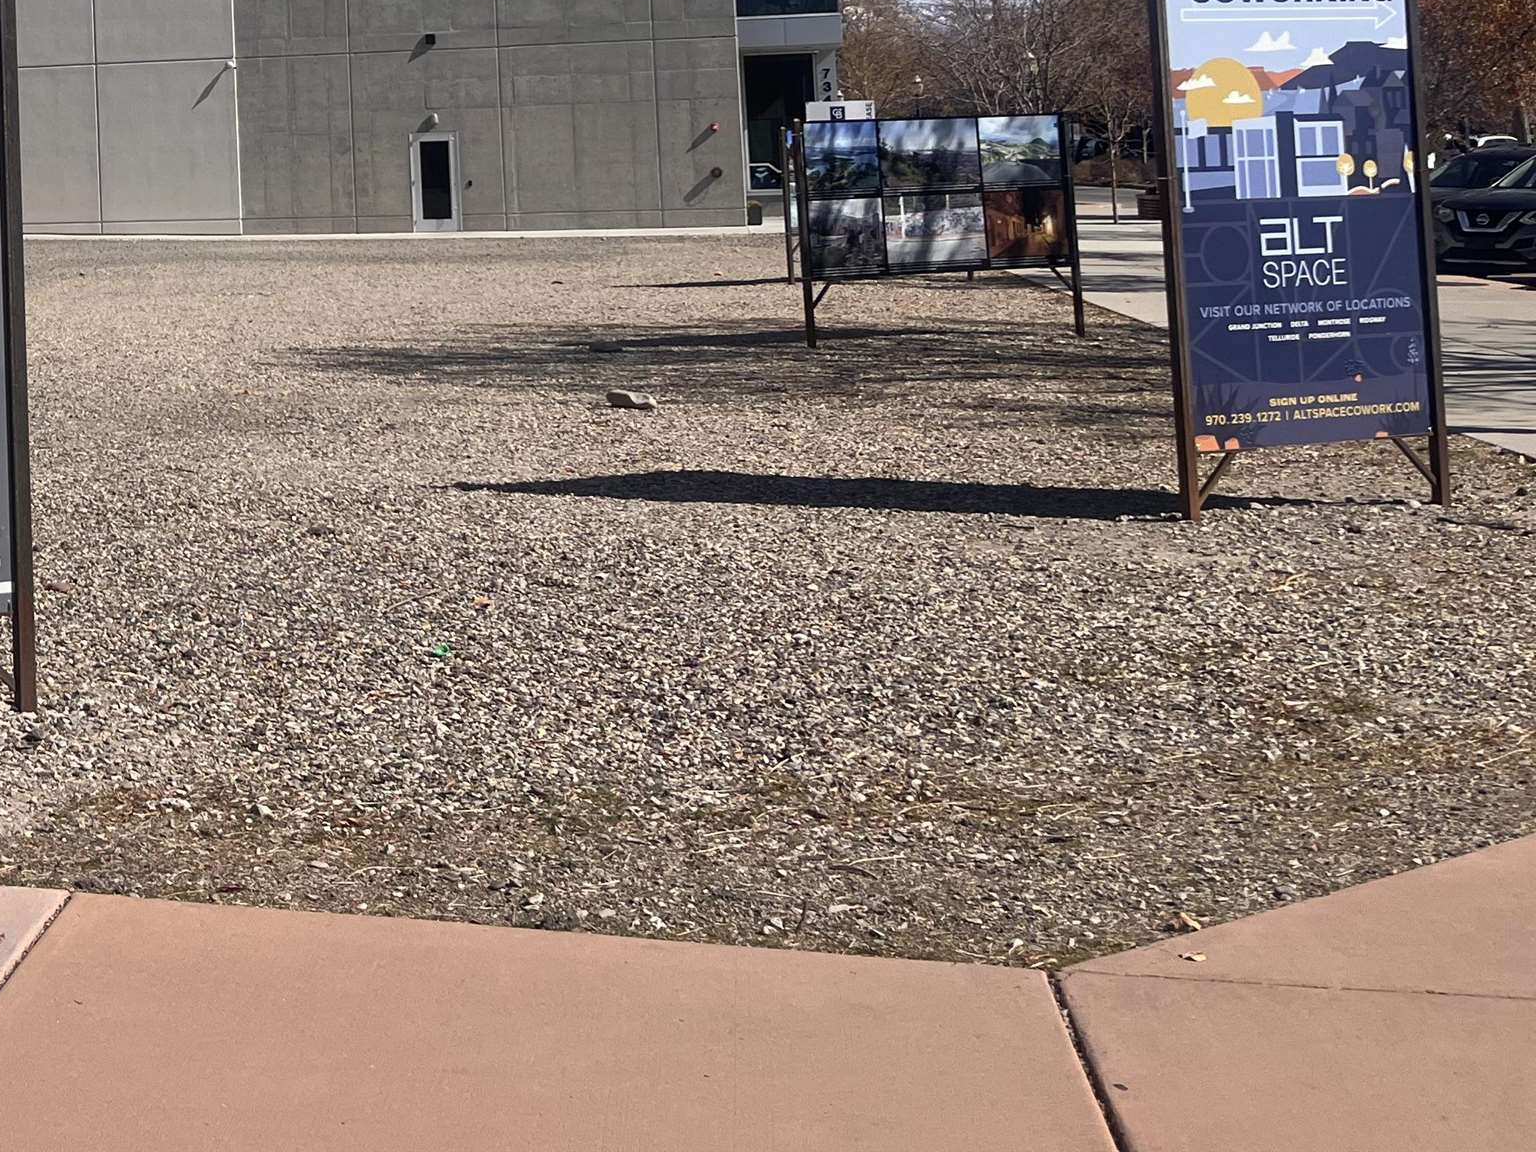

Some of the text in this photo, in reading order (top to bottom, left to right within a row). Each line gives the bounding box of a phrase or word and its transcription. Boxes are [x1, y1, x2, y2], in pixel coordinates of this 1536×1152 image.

[1262, 258, 1348, 289] SPACE
[1200, 296, 1411, 318] VISIT OUR NETWORK OF LOCATIONS
[1269, 393, 1359, 407] SIGN UP ONLINE
[1205, 402, 1420, 426] 970.239.1272 ALTSPACECOWORK.COM
